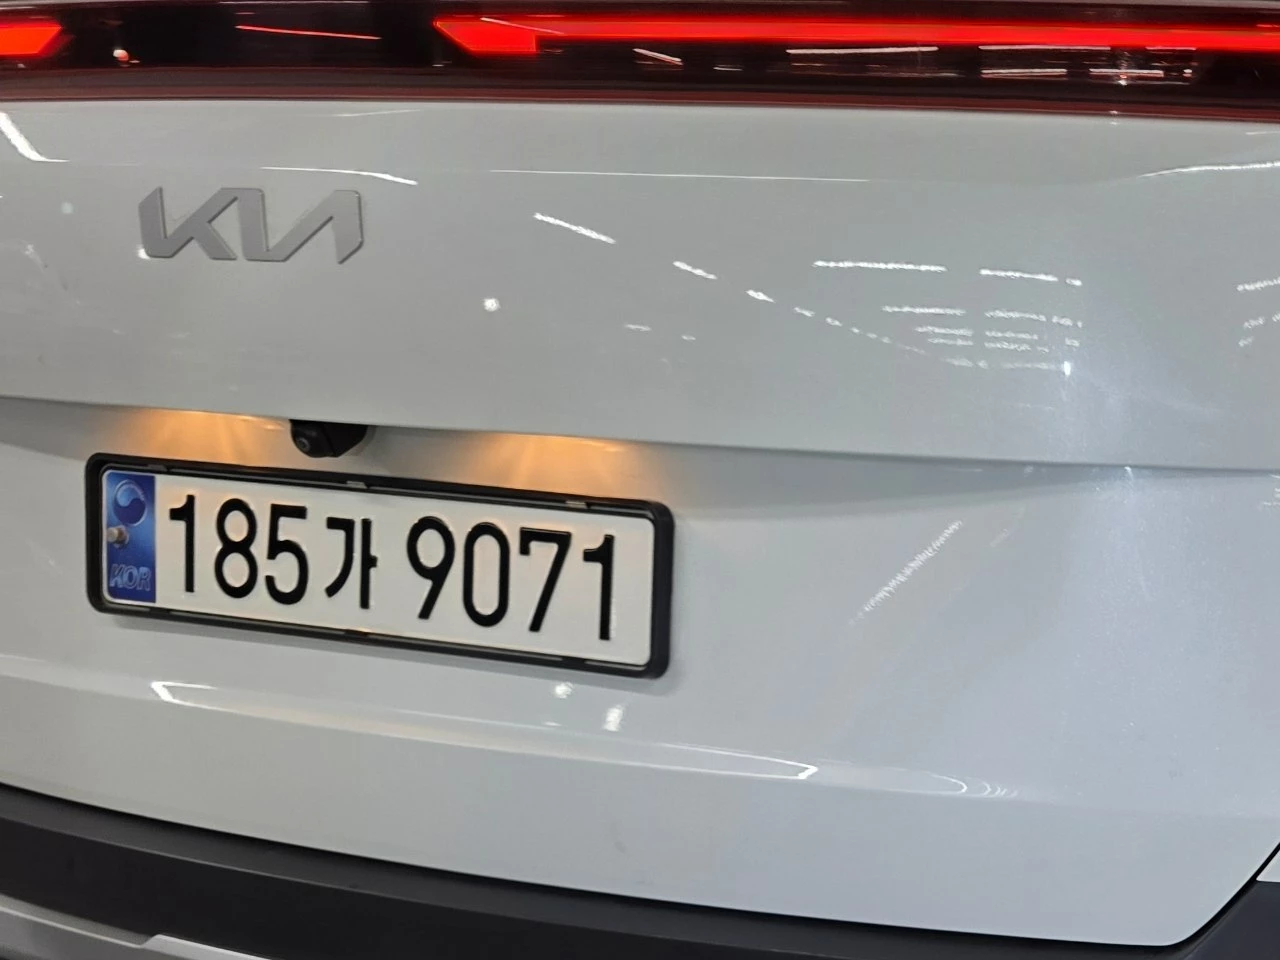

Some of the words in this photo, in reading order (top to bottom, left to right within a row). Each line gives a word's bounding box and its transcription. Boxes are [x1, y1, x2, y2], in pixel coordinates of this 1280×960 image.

[138, 186, 364, 264] KIA
[109, 563, 152, 592] KOR
[168, 494, 378, 610] 185가
[406, 515, 615, 641] 9071
